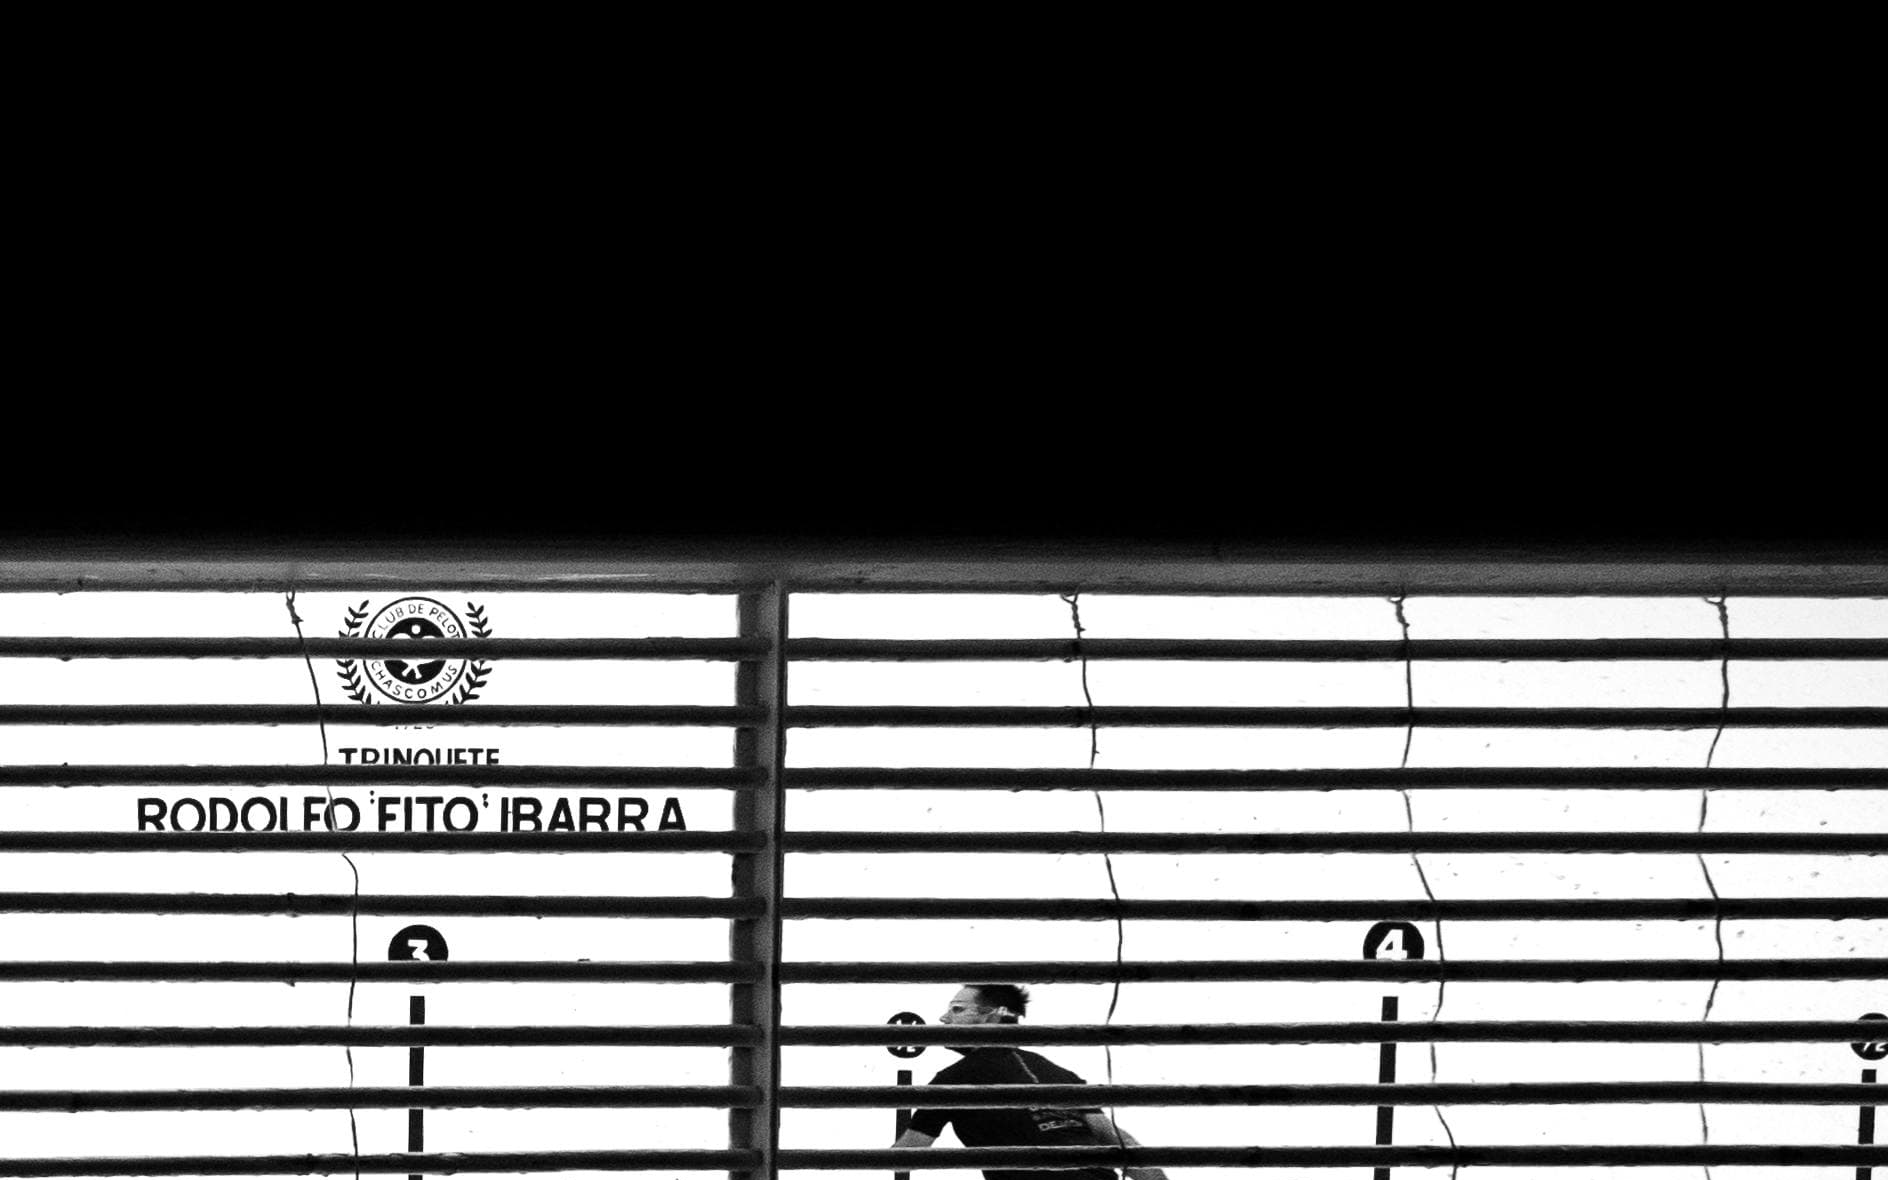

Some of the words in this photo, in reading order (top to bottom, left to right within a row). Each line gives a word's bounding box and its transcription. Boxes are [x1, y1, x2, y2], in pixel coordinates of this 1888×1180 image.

[372, 607, 404, 639] CLUB
[408, 604, 424, 614] DE
[429, 607, 461, 639] PELOT
[372, 661, 458, 699] CHASCOMUS
[137, 796, 361, 832] RODOLFO
[500, 797, 687, 832] IBARRA
[407, 939, 431, 962] 3
[1375, 928, 1408, 960] 4
